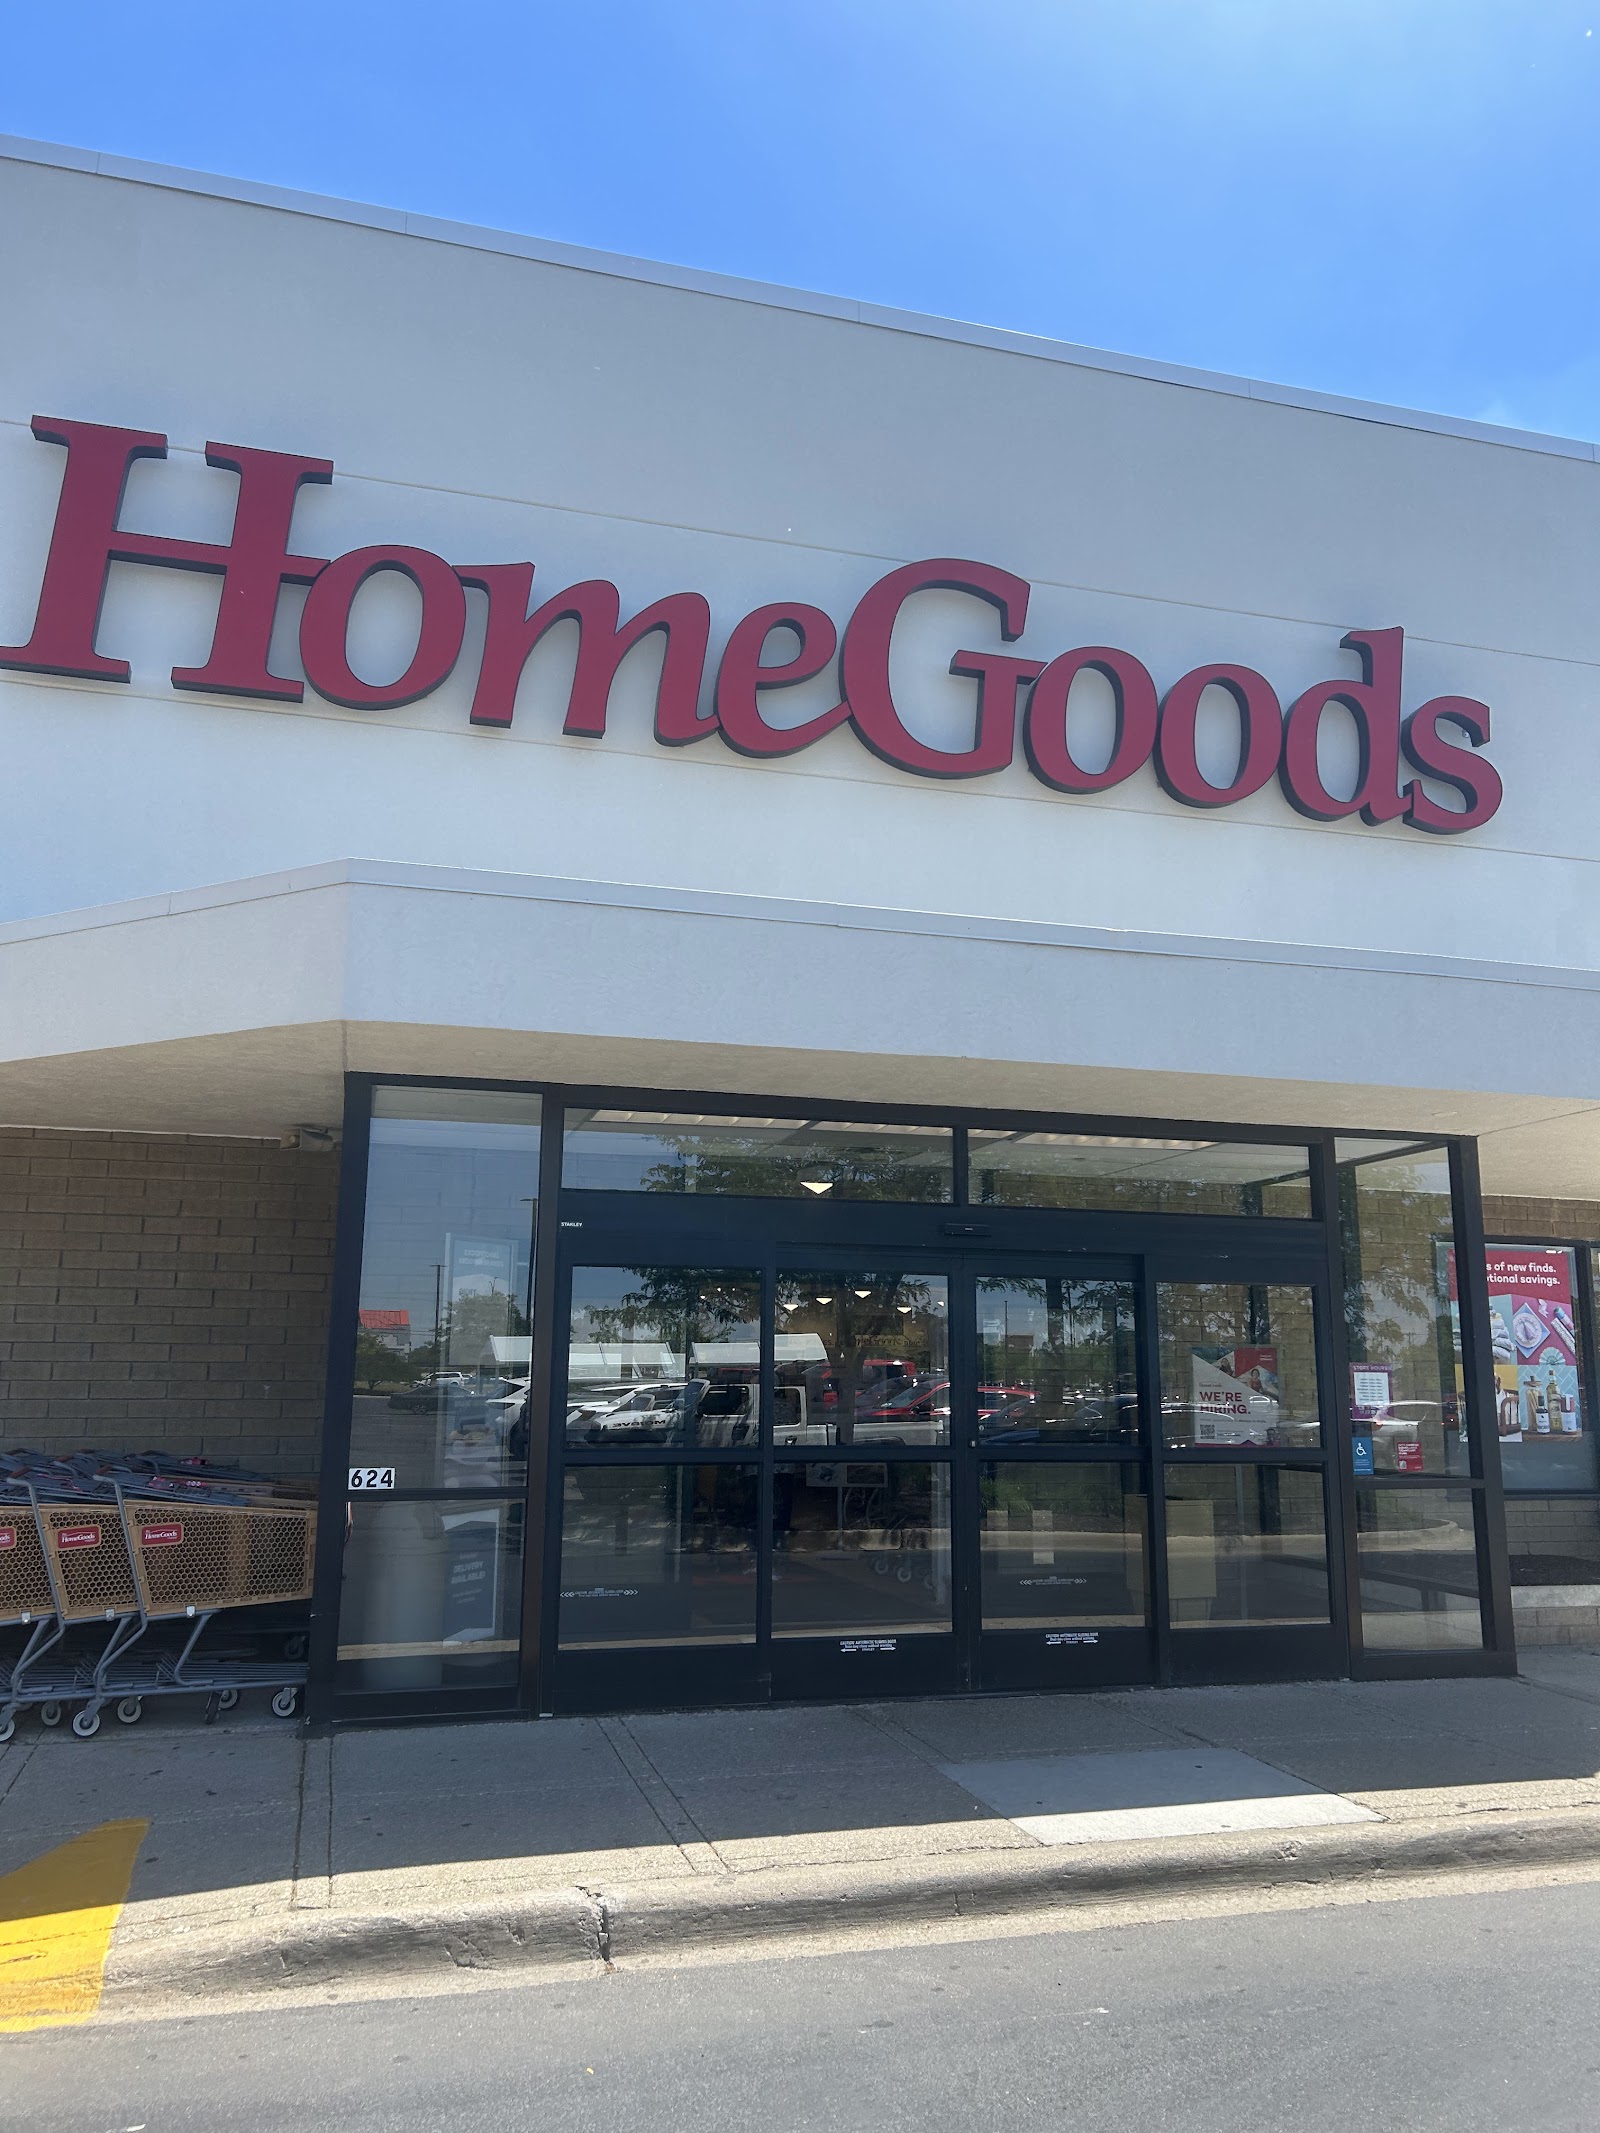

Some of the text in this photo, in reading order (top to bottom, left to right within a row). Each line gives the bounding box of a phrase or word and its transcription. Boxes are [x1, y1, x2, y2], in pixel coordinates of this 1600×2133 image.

[0, 415, 1503, 835] HomeGoods
[1494, 1261, 1505, 1271] of
[1507, 1264, 1526, 1272] new
[1528, 1262, 1557, 1273] finds.
[1520, 1274, 1561, 1287] savings.
[1199, 1391, 1242, 1402] WE'RE
[351, 1469, 393, 1488] 624
[61, 1532, 96, 1543] HomeGoods
[145, 1530, 178, 1540] HomeGoods
